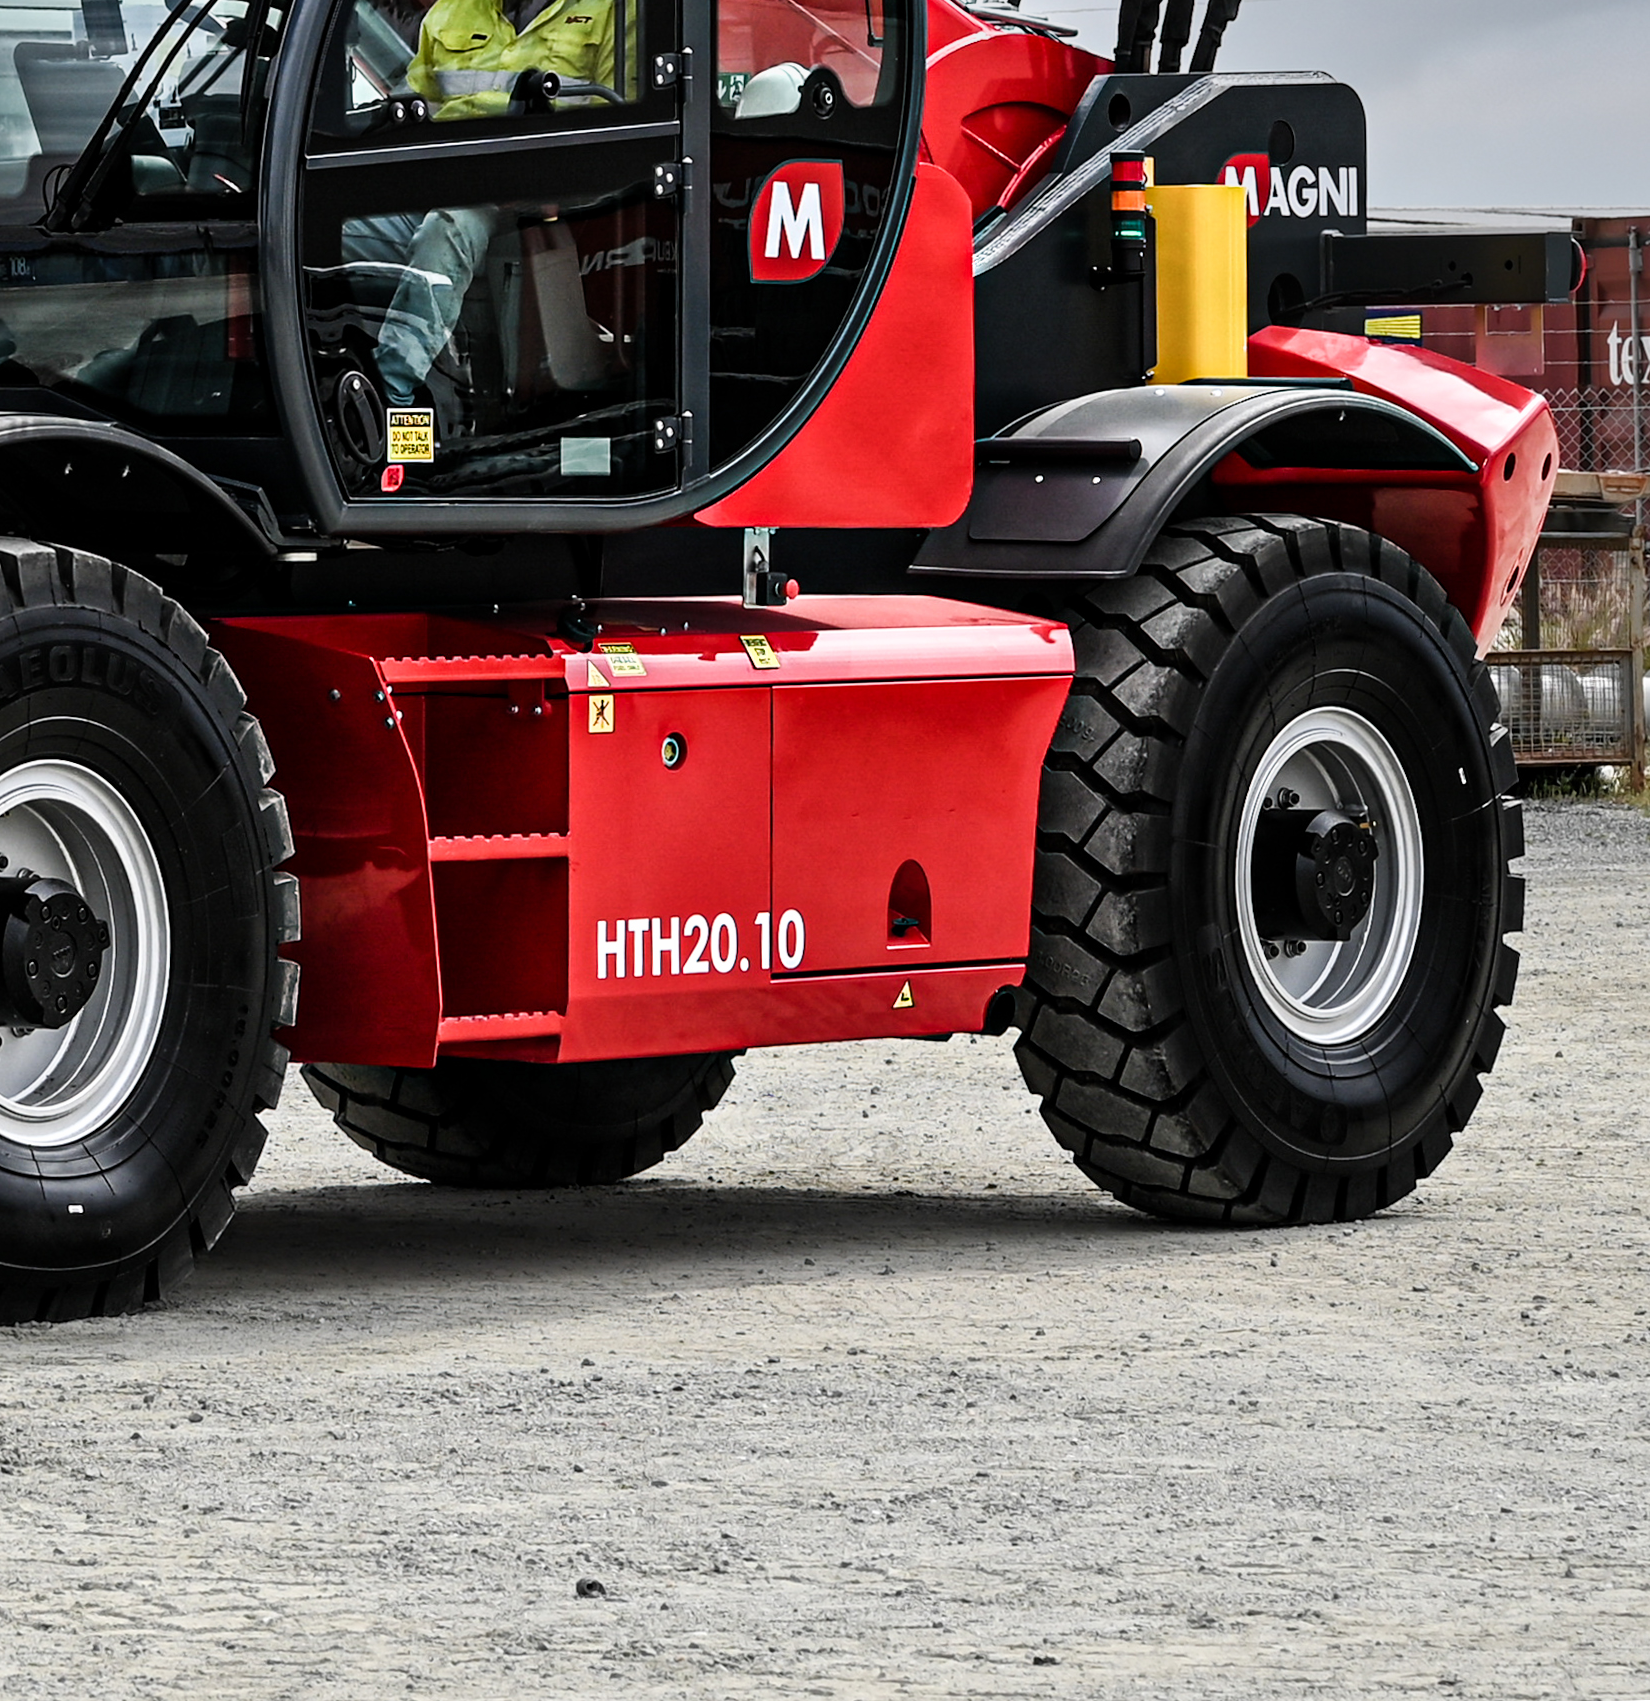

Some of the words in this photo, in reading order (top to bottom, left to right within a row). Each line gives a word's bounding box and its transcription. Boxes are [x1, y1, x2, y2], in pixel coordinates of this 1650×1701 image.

[764, 181, 825, 260] M
[391, 414, 430, 426] ATTENTION
[392, 431, 401, 442] DO
[402, 431, 413, 442] NOT
[414, 431, 428, 442] TALK
[391, 444, 399, 454] TO
[400, 444, 430, 454] OPERATOR
[597, 909, 805, 979] HTH20.10
